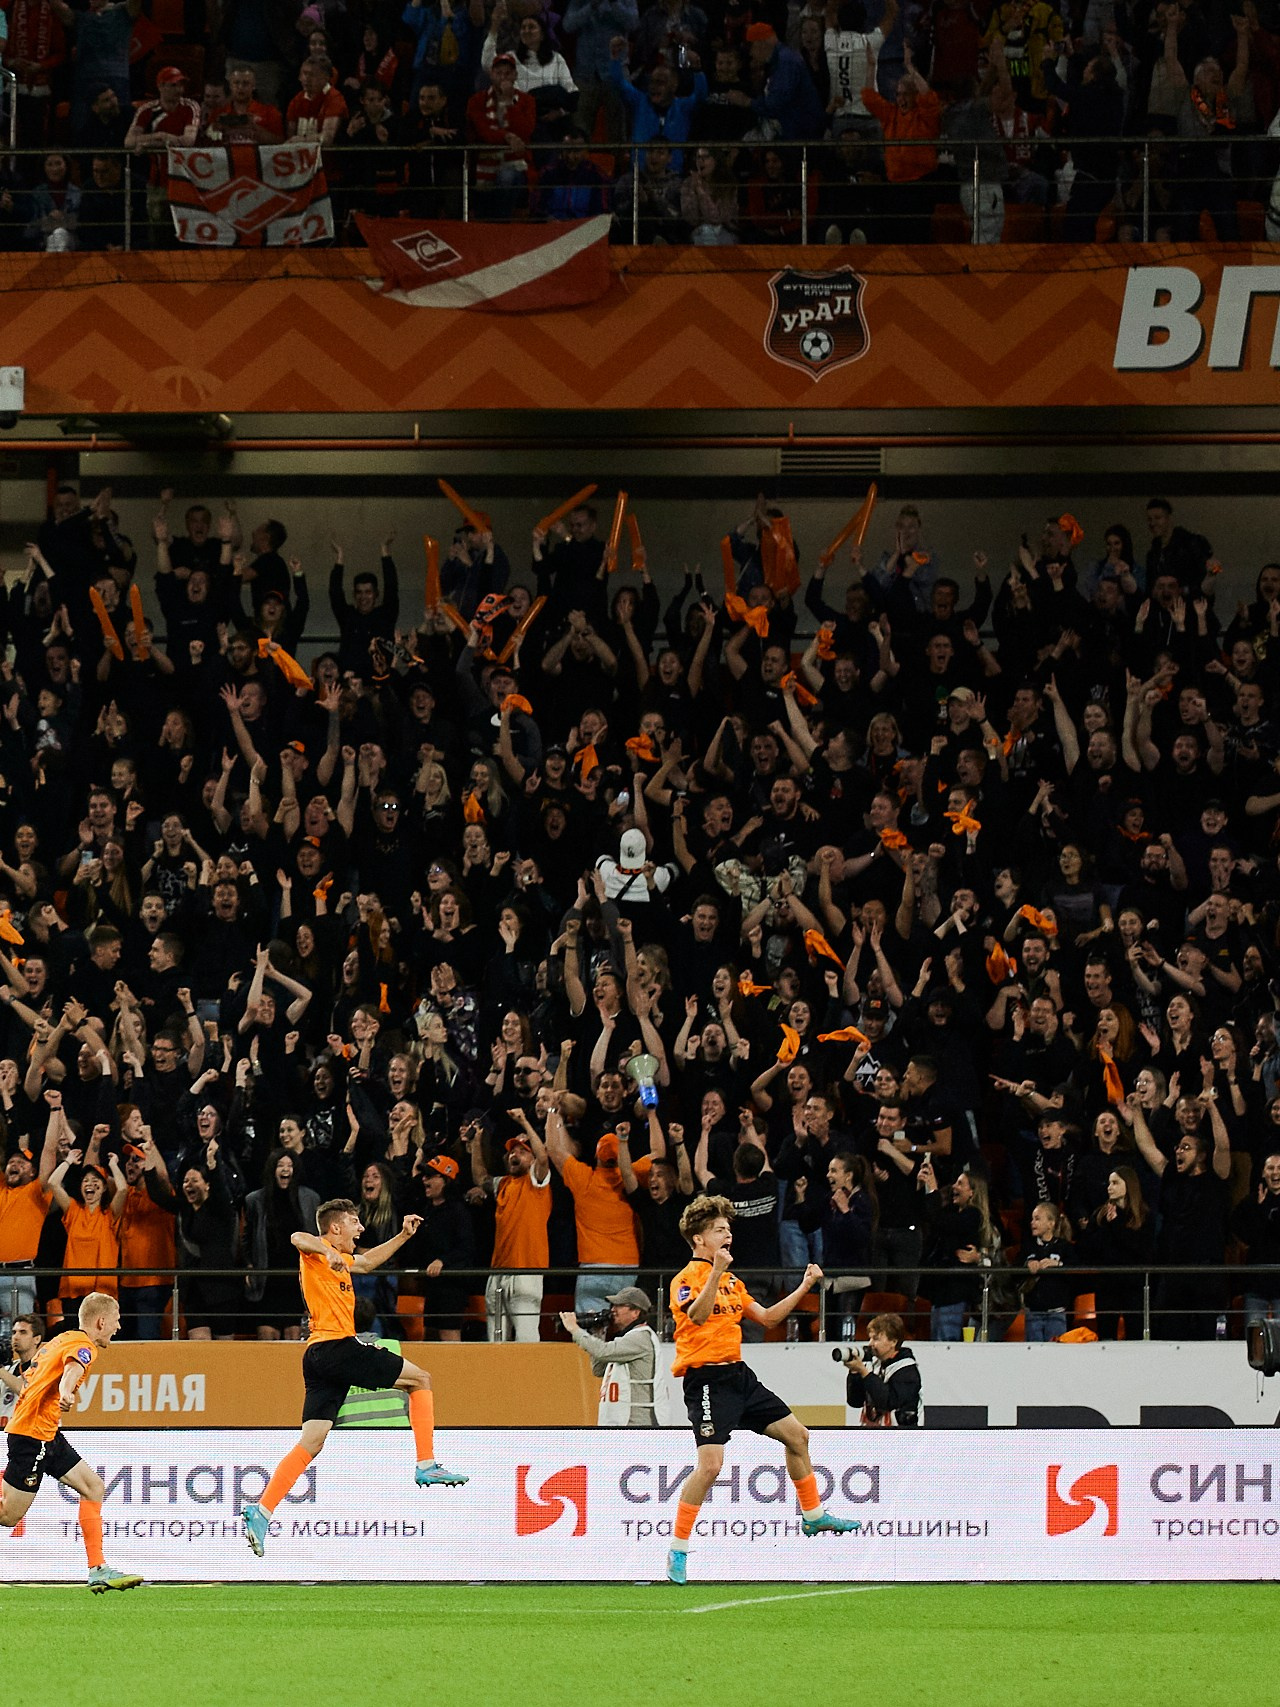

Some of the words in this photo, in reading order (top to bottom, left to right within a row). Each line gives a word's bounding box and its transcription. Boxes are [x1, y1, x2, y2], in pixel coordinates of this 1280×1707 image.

[781, 295, 852, 333] УРАЛ
[291, 1519, 424, 1538] машины
[621, 1519, 844, 1541] траспортн
[1151, 1518, 1280, 1541] транспо
